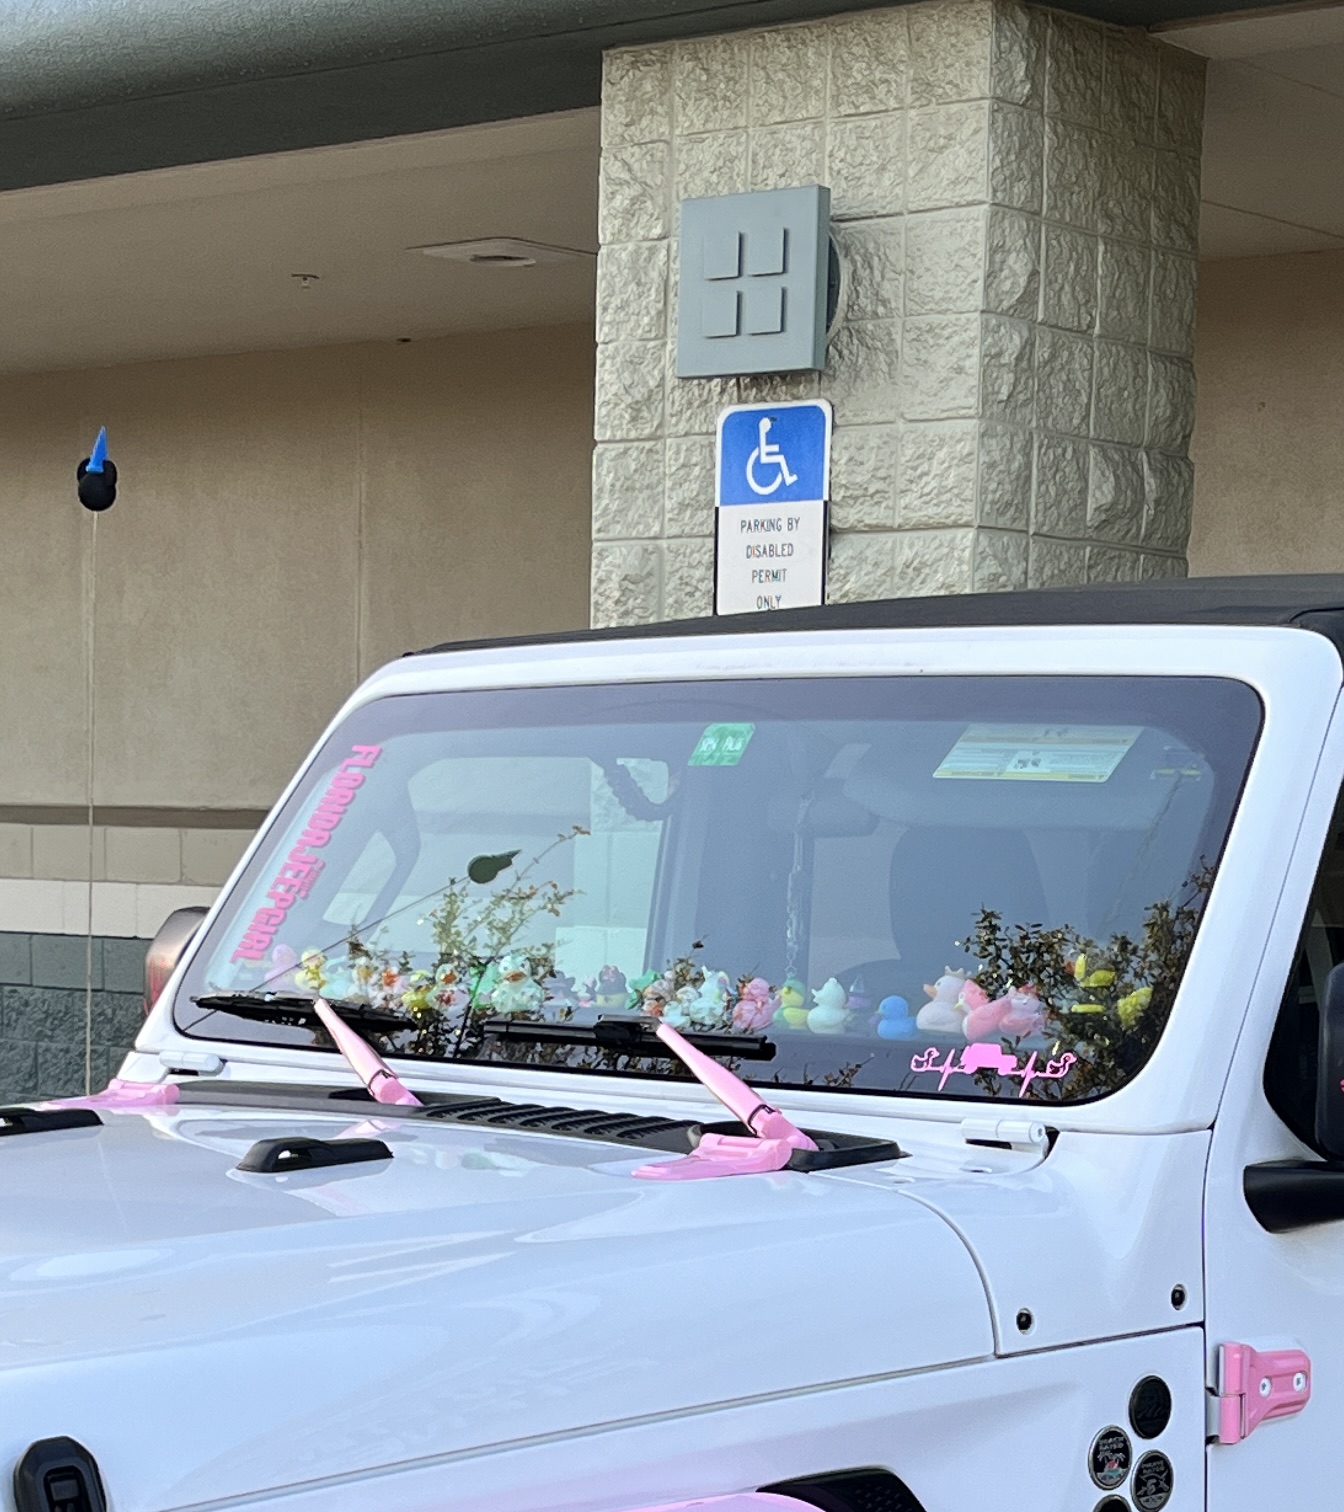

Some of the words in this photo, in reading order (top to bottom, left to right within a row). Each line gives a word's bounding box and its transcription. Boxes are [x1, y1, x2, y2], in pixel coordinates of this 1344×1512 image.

[740, 517, 782, 533] PARKING
[787, 517, 800, 531] BY
[746, 543, 794, 559] DISABLED
[752, 569, 787, 584] PERMIT
[756, 595, 782, 610] ONLY
